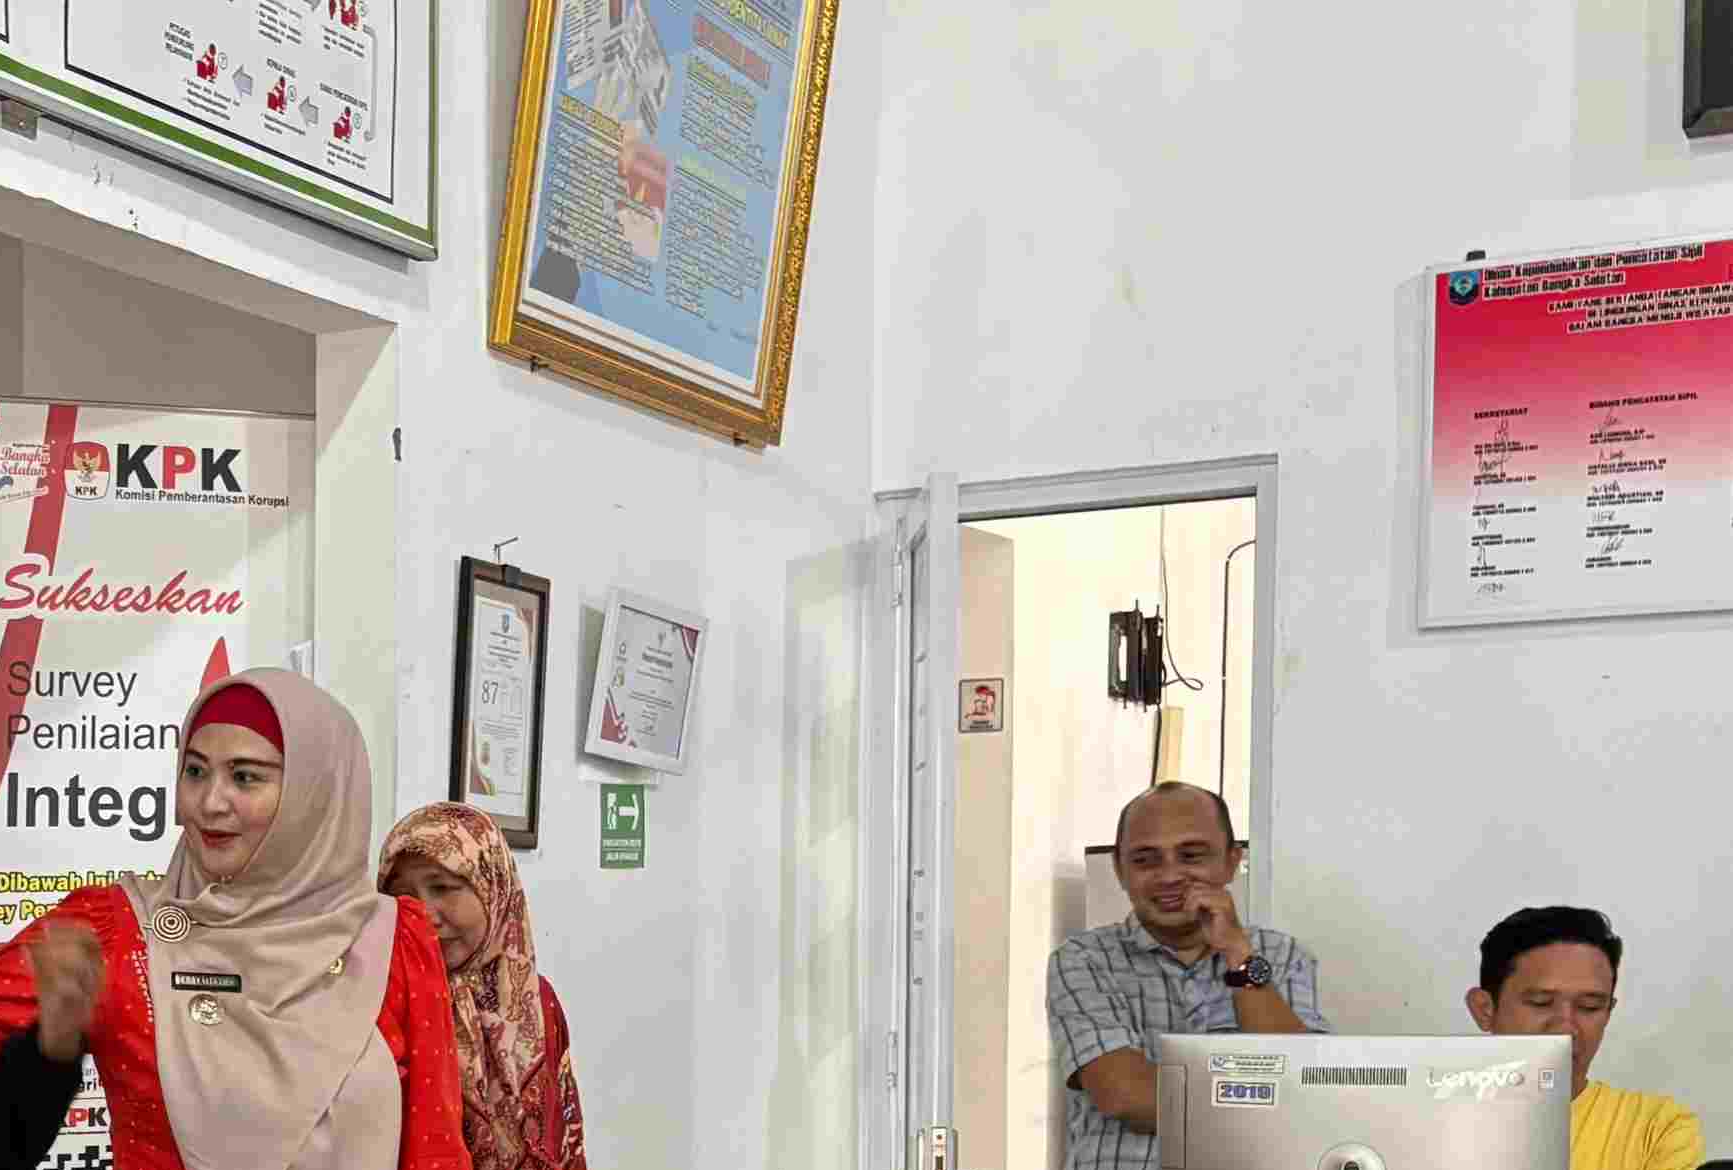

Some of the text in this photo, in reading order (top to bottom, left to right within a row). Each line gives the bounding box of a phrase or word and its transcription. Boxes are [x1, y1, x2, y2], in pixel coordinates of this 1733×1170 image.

[115, 443, 243, 493] KPK
[75, 485, 98, 497] KPK
[115, 488, 290, 508] Komisi Pemberantasan Korupsi
[7, 662, 138, 706] Survey
[7, 716, 180, 751] Penilaian
[6, 772, 179, 842] Integ
[69, 1106, 108, 1127] PK
